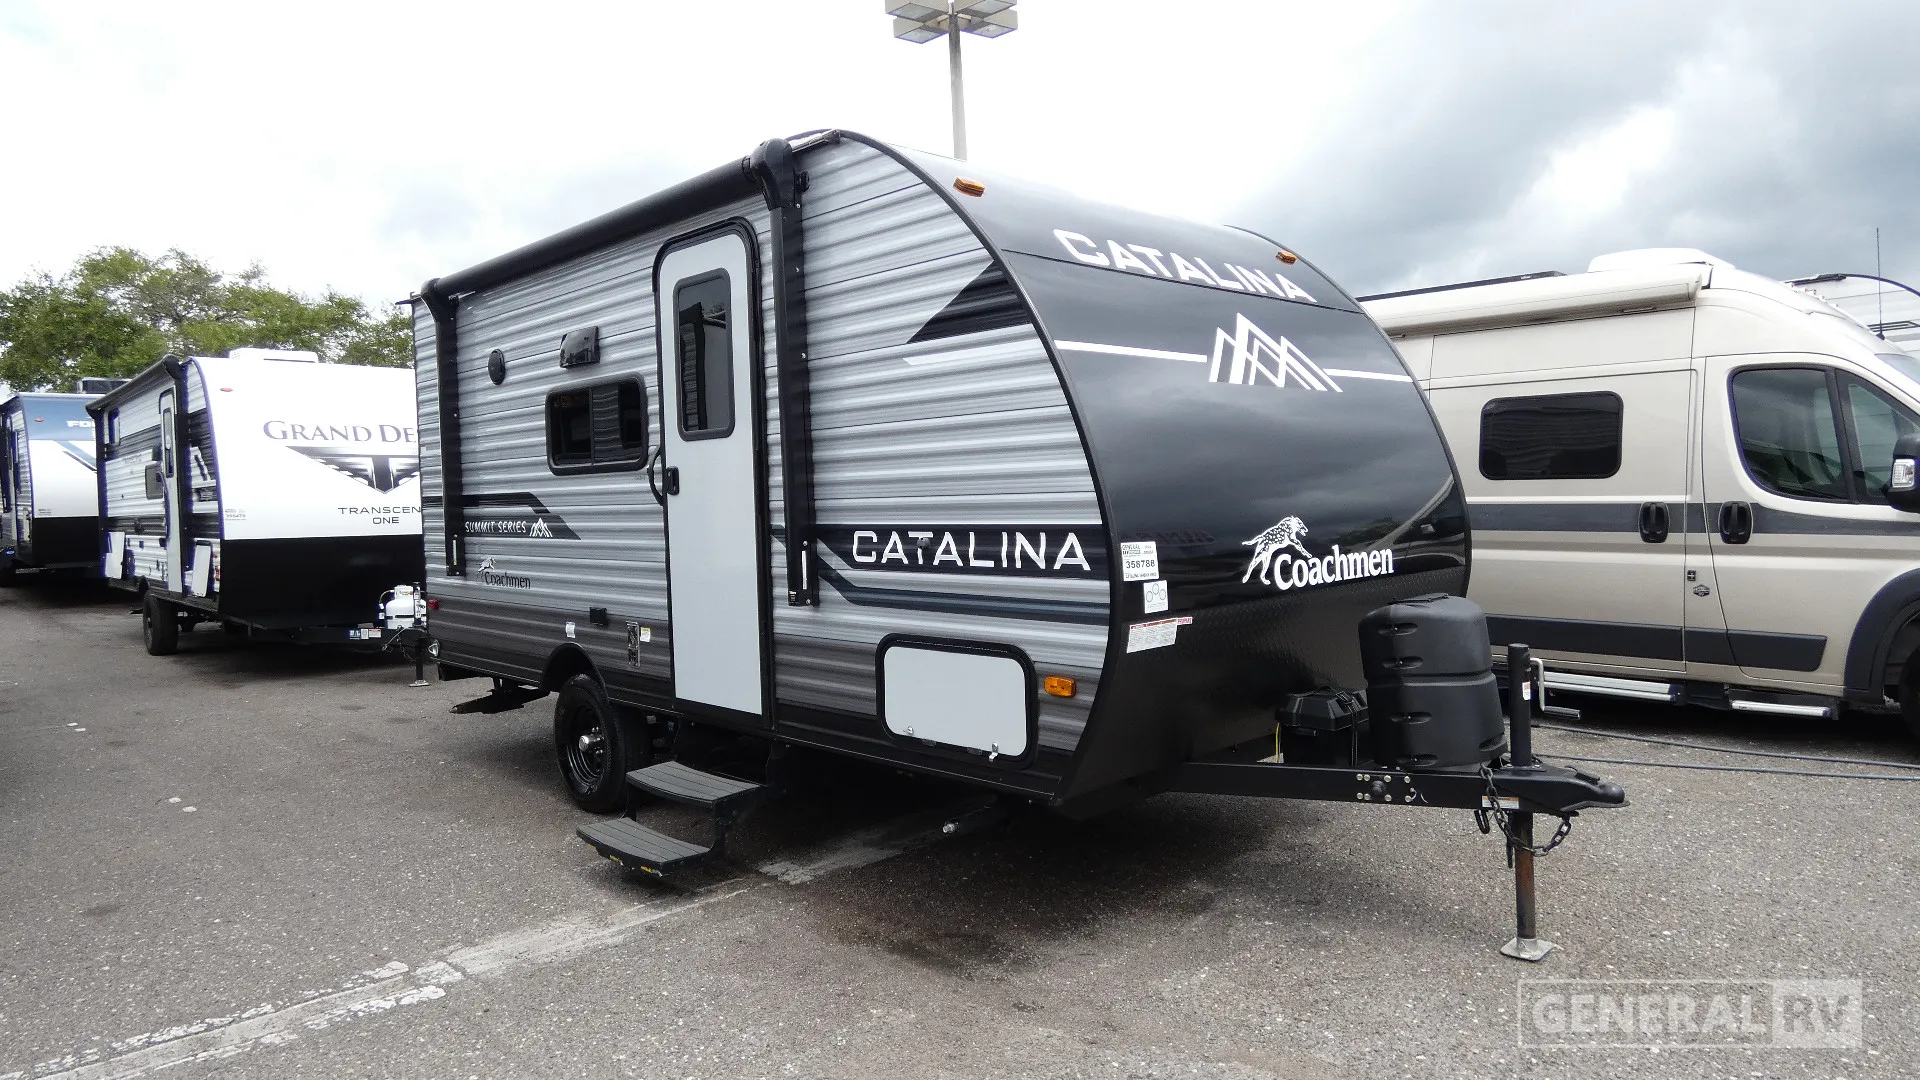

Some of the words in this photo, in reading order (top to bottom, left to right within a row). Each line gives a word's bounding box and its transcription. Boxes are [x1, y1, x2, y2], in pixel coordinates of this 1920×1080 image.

[1053, 229, 1318, 303] CATALINA
[263, 420, 372, 442] GRAND
[373, 516, 400, 525] ONE
[465, 521, 496, 533] SUMMIT
[497, 520, 527, 533] SERIES
[852, 530, 1091, 570] CATALINA
[1125, 559, 1156, 569] 358788
[1274, 544, 1395, 591] Coachmen
[484, 571, 531, 589] Coachmen
